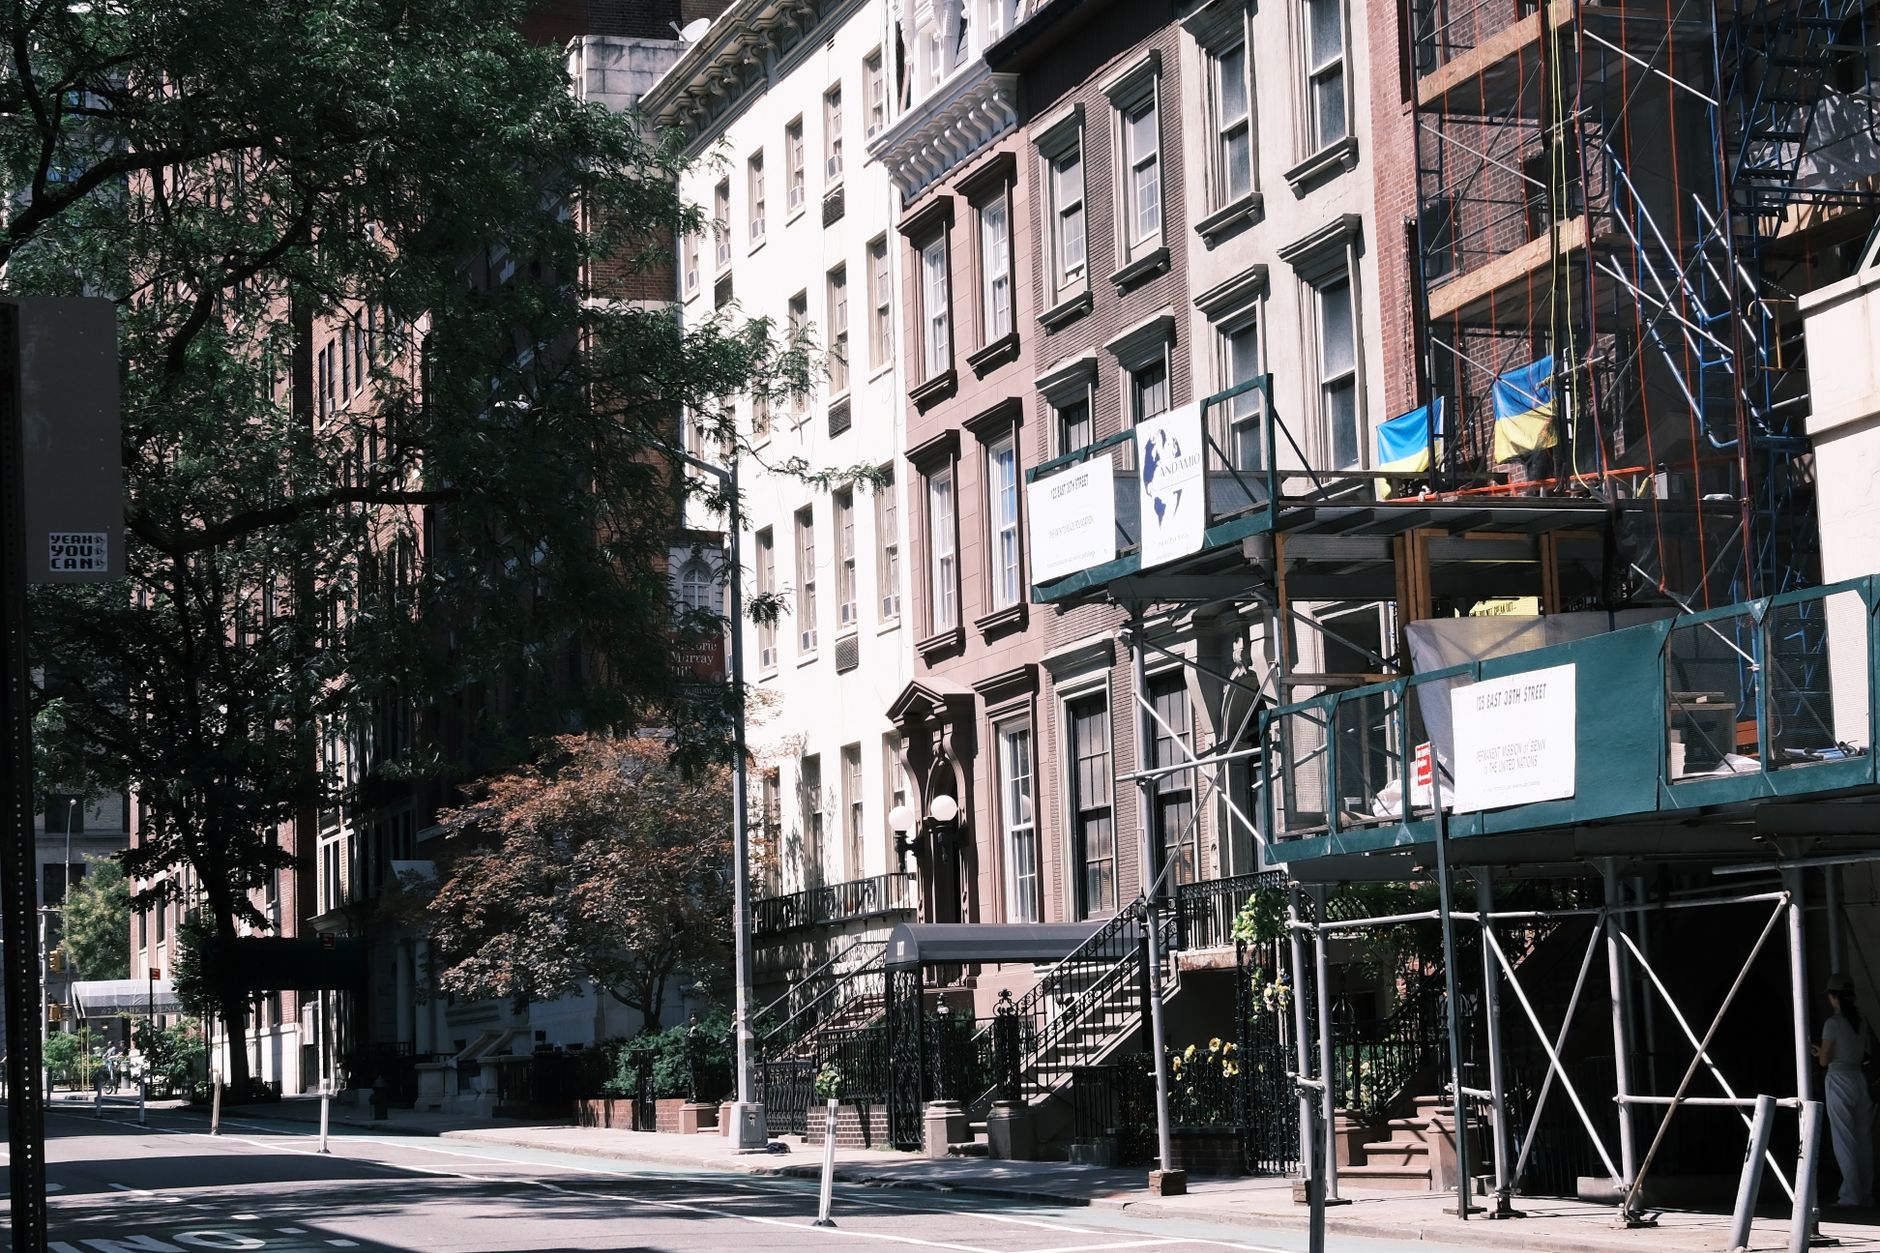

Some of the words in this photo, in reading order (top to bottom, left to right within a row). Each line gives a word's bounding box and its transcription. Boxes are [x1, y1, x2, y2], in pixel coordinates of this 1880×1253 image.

[50, 535, 93, 544] YEAH
[50, 545, 93, 557] YOU
[50, 558, 93, 569] CAN
[1486, 692, 1502, 709] EAST
[1523, 682, 1547, 703] STREET
